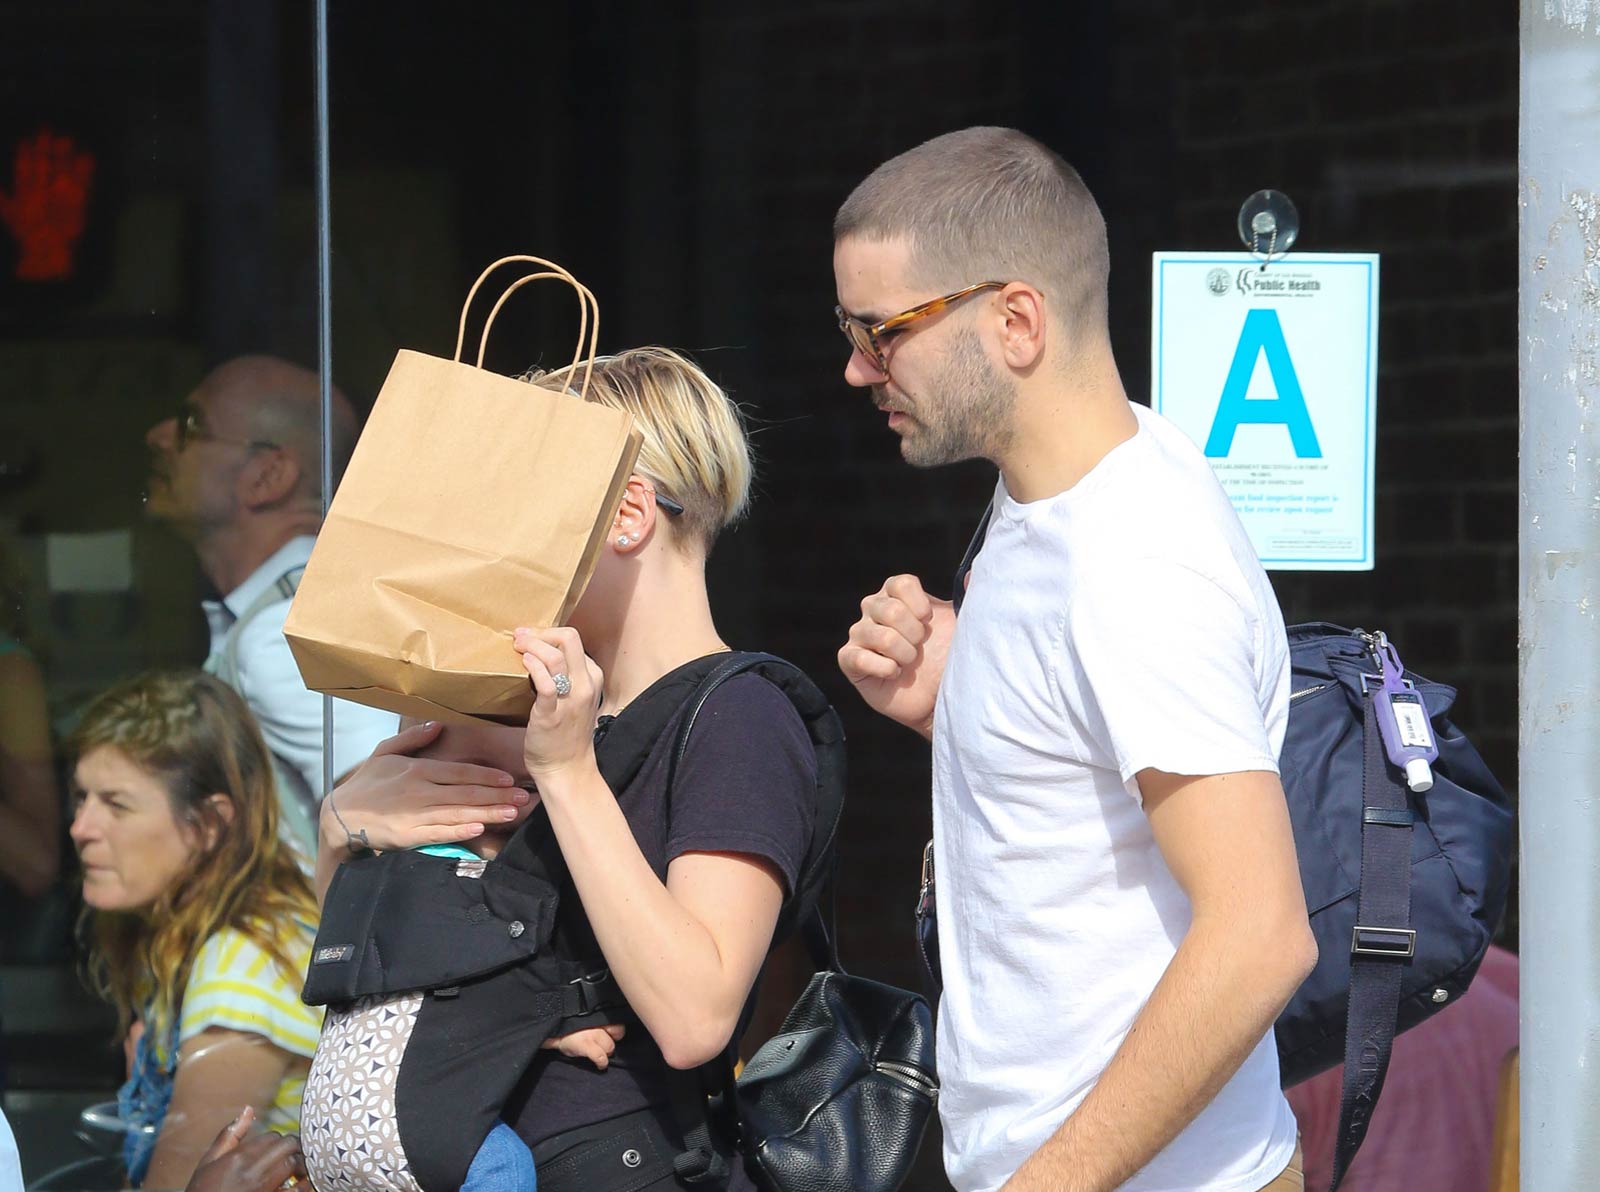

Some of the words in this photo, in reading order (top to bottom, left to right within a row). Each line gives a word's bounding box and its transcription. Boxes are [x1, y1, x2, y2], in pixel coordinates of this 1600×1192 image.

[1254, 280, 1285, 291] Public
[1288, 280, 1321, 291] Health
[1203, 309, 1323, 458] A
